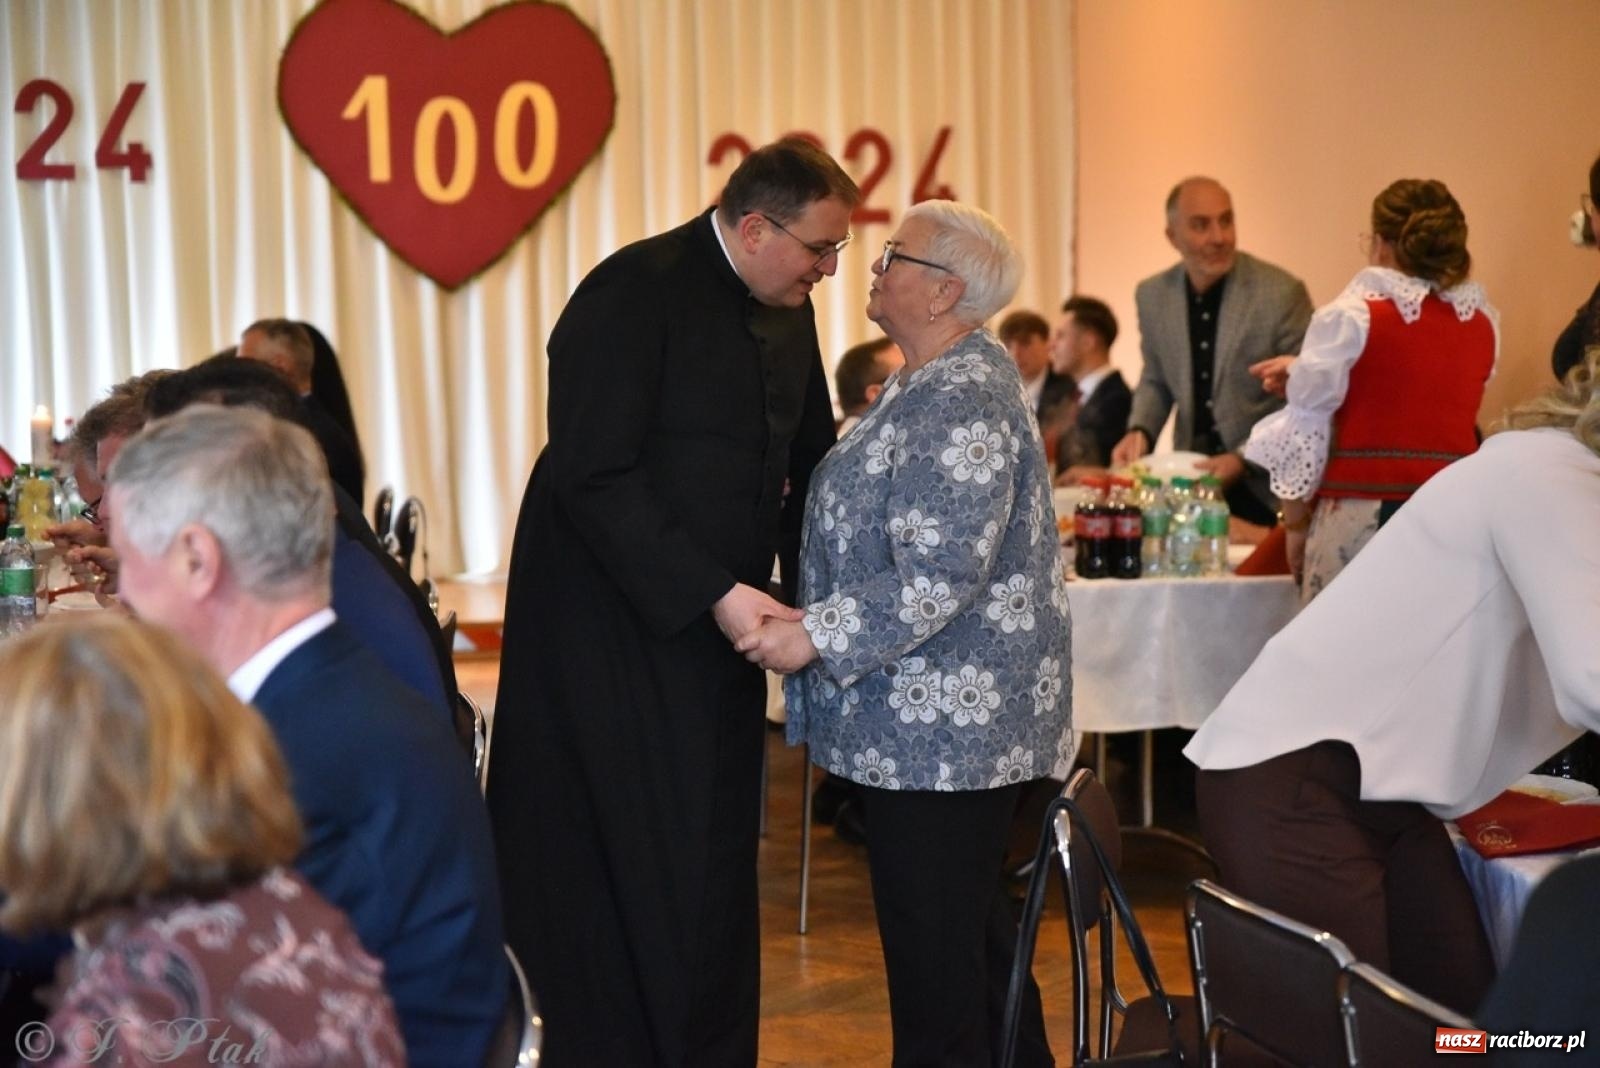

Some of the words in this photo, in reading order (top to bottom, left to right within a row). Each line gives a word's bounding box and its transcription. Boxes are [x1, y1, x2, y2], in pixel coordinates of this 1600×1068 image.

[14, 79, 152, 182] 24
[341, 75, 558, 203] 100
[706, 126, 958, 224] 24
